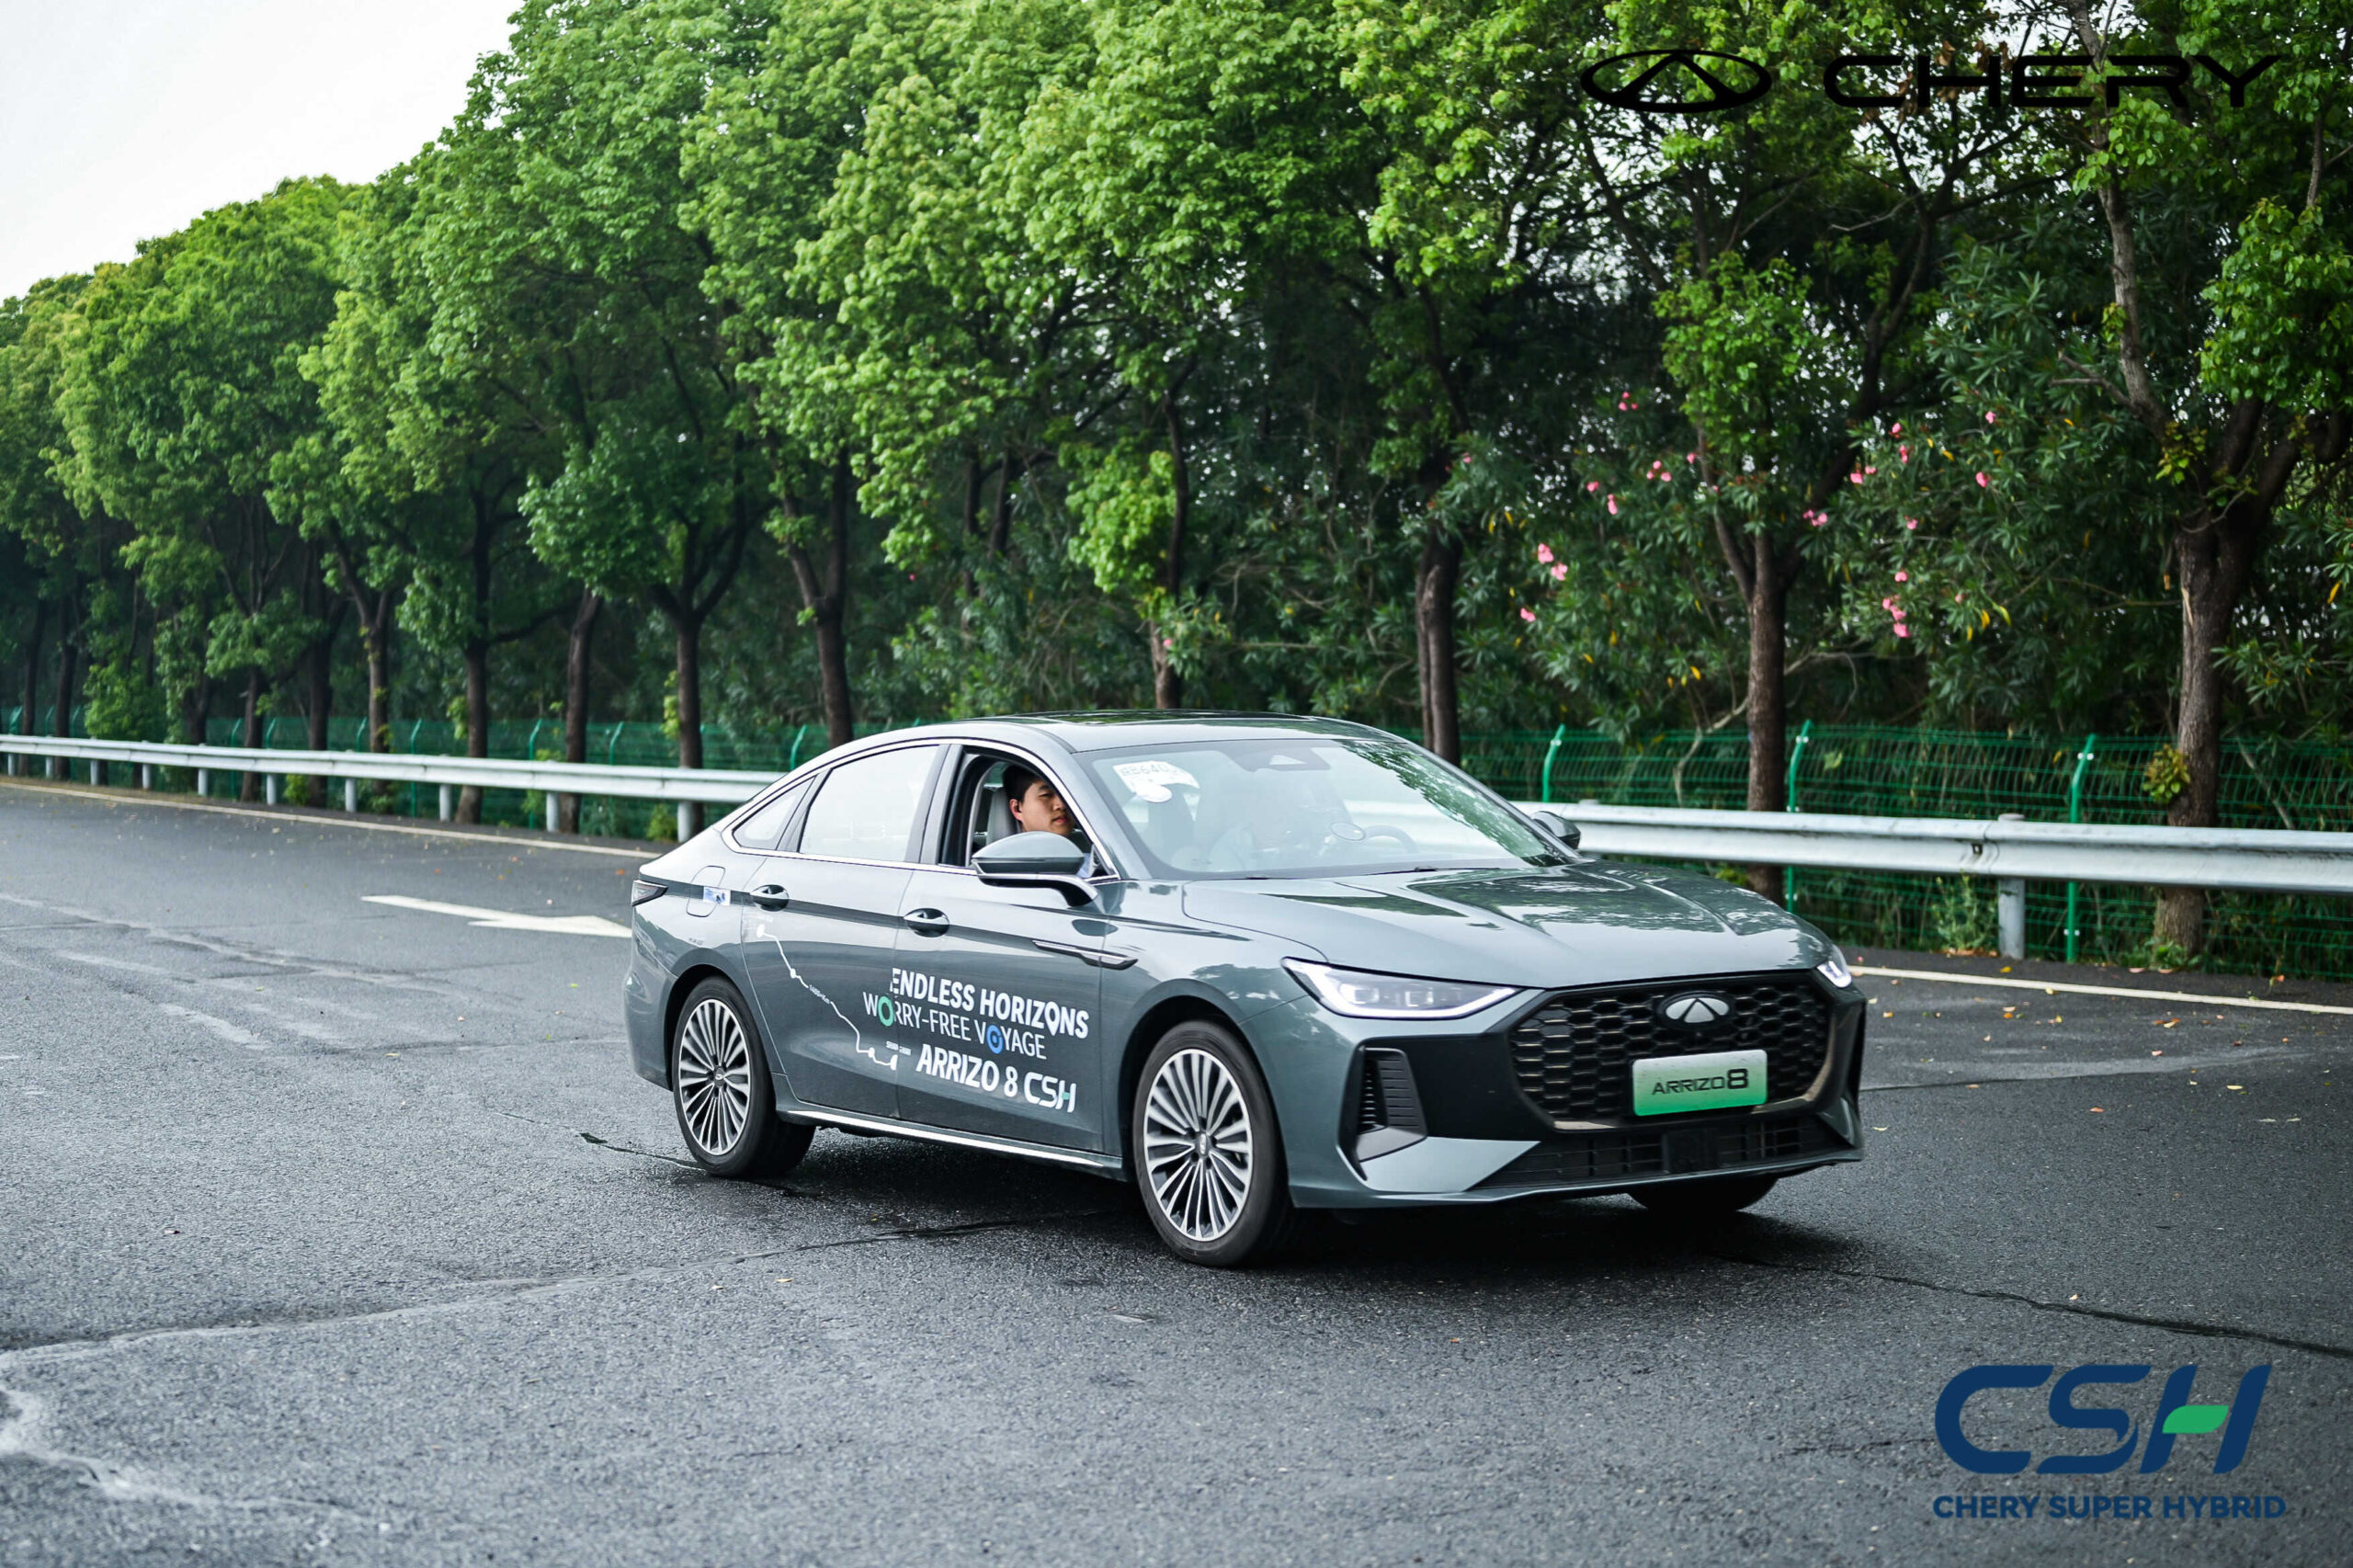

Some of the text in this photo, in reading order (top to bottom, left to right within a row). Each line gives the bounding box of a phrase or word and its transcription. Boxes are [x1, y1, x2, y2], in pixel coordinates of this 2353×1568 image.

[863, 992, 1047, 1059] WORRY-FREE VOYAGE
[890, 968, 1089, 1039] ENDLESS HORIZONS
[915, 1043, 1076, 1112] ARRIZO 8 CSH
